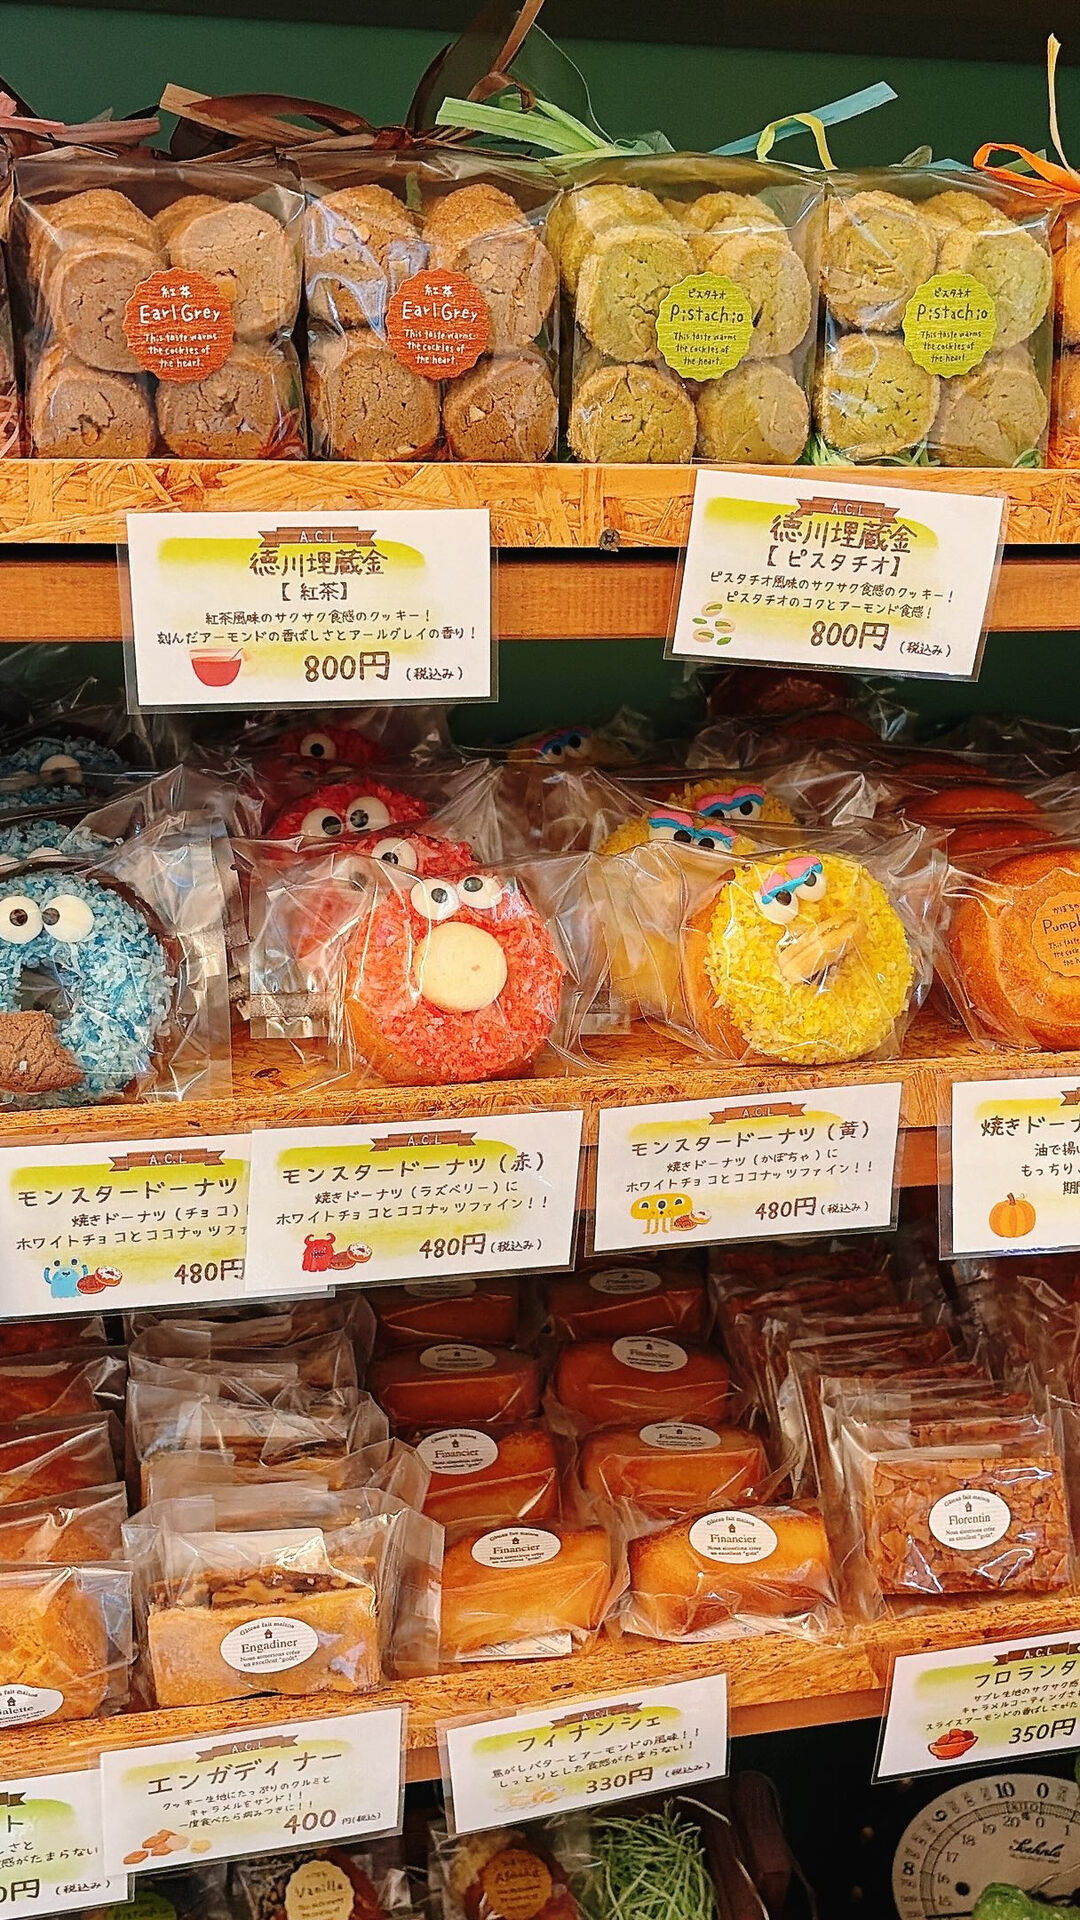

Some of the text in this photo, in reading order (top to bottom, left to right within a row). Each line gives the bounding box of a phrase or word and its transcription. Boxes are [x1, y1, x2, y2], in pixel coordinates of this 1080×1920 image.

[689, 288, 726, 299] ピスタチオ
[934, 287, 971, 298] ピスタチオ
[140, 304, 220, 324] Earl Grey
[402, 301, 478, 322] Earl Grey
[670, 304, 744, 323] Pistachio
[916, 303, 988, 322] Pistachio
[145, 333, 163, 343] This
[165, 333, 188, 342] taste
[404, 329, 422, 339] This
[425, 330, 445, 340] taste
[674, 332, 737, 341] This taste warms
[921, 331, 982, 340] This taste warms
[148, 344, 211, 355] the cockles of
[407, 341, 466, 354] the cockles of
[676, 345, 730, 355] the cockles of
[924, 342, 976, 351] the cockles of
[160, 359, 173, 368] the
[416, 355, 429, 364] the
[683, 357, 695, 365] the
[931, 355, 943, 363] the
[830, 502, 866, 518] A.C.L
[299, 529, 339, 545] A.C.L
[770, 513, 917, 554] 徳川埋蔵金
[249, 549, 389, 577] 徳川埋蔵金
[766, 545, 901, 578] 【ピスタチオ】
[710, 570, 955, 604] ピスタチオ風味のサクサク食感のクッキー！
[726, 590, 933, 620] ピスタチオのコクとアーモンド食感！
[205, 609, 432, 626] 紅茶風味のサクサク食感のクッキー！
[157, 626, 477, 646] 刻んだアーモンドの香ばしさとアールグレイの香り！
[809, 620, 952, 657] 800円 （税込み）
[304, 651, 464, 683] 800円 （税込み）
[407, 1133, 443, 1147] A.C.L
[149, 1151, 187, 1165] A.C.L
[666, 1148, 838, 1174] 焼きドーナツ（かぼちゃ）に
[625, 1161, 873, 1193] ホワイトチョコとココナッツファイン！！
[1021, 1162, 1080, 1177] もっちり
[17, 1177, 238, 1207] モンスタードーナツ
[314, 1179, 519, 1205] 焼きドーナツ（ラズベリー）に
[1062, 1181, 1080, 1196] 期
[71, 1204, 249, 1228] 焼きドーナツ（チョコ）
[276, 1196, 548, 1227] ホワイトチョコとココナッツファイン！！
[754, 1196, 869, 1221] 480円 （税込み）
[418, 1233, 543, 1261] 480円 （税込み）
[174, 1258, 245, 1286] 480円
[948, 1512, 991, 1526] Florentin
[710, 1533, 757, 1543] Financier
[492, 1544, 540, 1555] Financier
[241, 1639, 298, 1653] Engadiner
[1023, 1647, 1053, 1660] A.C.L
[974, 1660, 1078, 1689] フロランタ
[962, 1690, 1080, 1715] キャラメルコーティングさ
[0, 1706, 34, 1716] alette
[517, 1716, 661, 1753] フィナンシェ
[1008, 1717, 1077, 1745] 350円
[499, 1741, 694, 1789] しっとりとした食感がたまらない！
[147, 1752, 342, 1796] エンガディナー
[585, 1766, 655, 1795] 330円
[995, 1781, 1015, 1798] 10
[283, 1809, 337, 1835] 400
[933, 1809, 948, 1823] 9
[1002, 1815, 1021, 1828] 20
[0, 1841, 34, 1855] さと
[902, 1861, 915, 1876] 8
[55, 1880, 111, 1896] （税込み）
